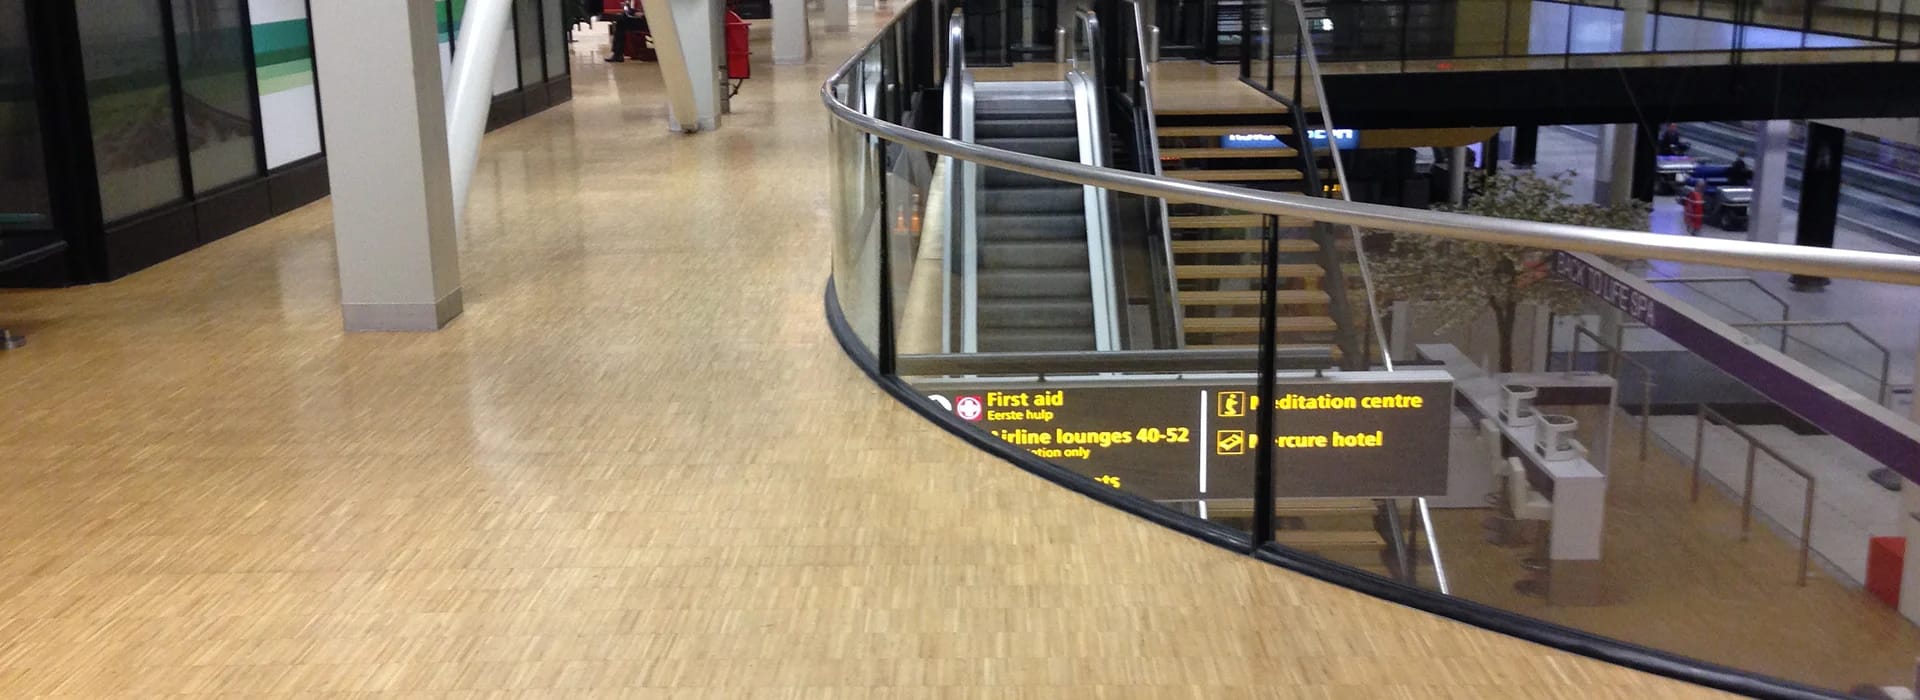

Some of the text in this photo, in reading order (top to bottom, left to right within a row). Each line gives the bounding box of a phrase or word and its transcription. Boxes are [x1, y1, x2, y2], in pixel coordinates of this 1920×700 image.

[1587, 267, 1602, 294] TO
[1603, 274, 1629, 312] LIFE
[1630, 290, 1655, 326] SPA
[987, 390, 1064, 407] First aid
[1250, 393, 1423, 411] ditation centre
[987, 409, 1054, 422] Eerste hulp
[1056, 428, 1132, 447] lounges
[1135, 427, 1190, 443] 40-52
[1248, 430, 1383, 449] rcure hotel
[1063, 446, 1091, 459] only
